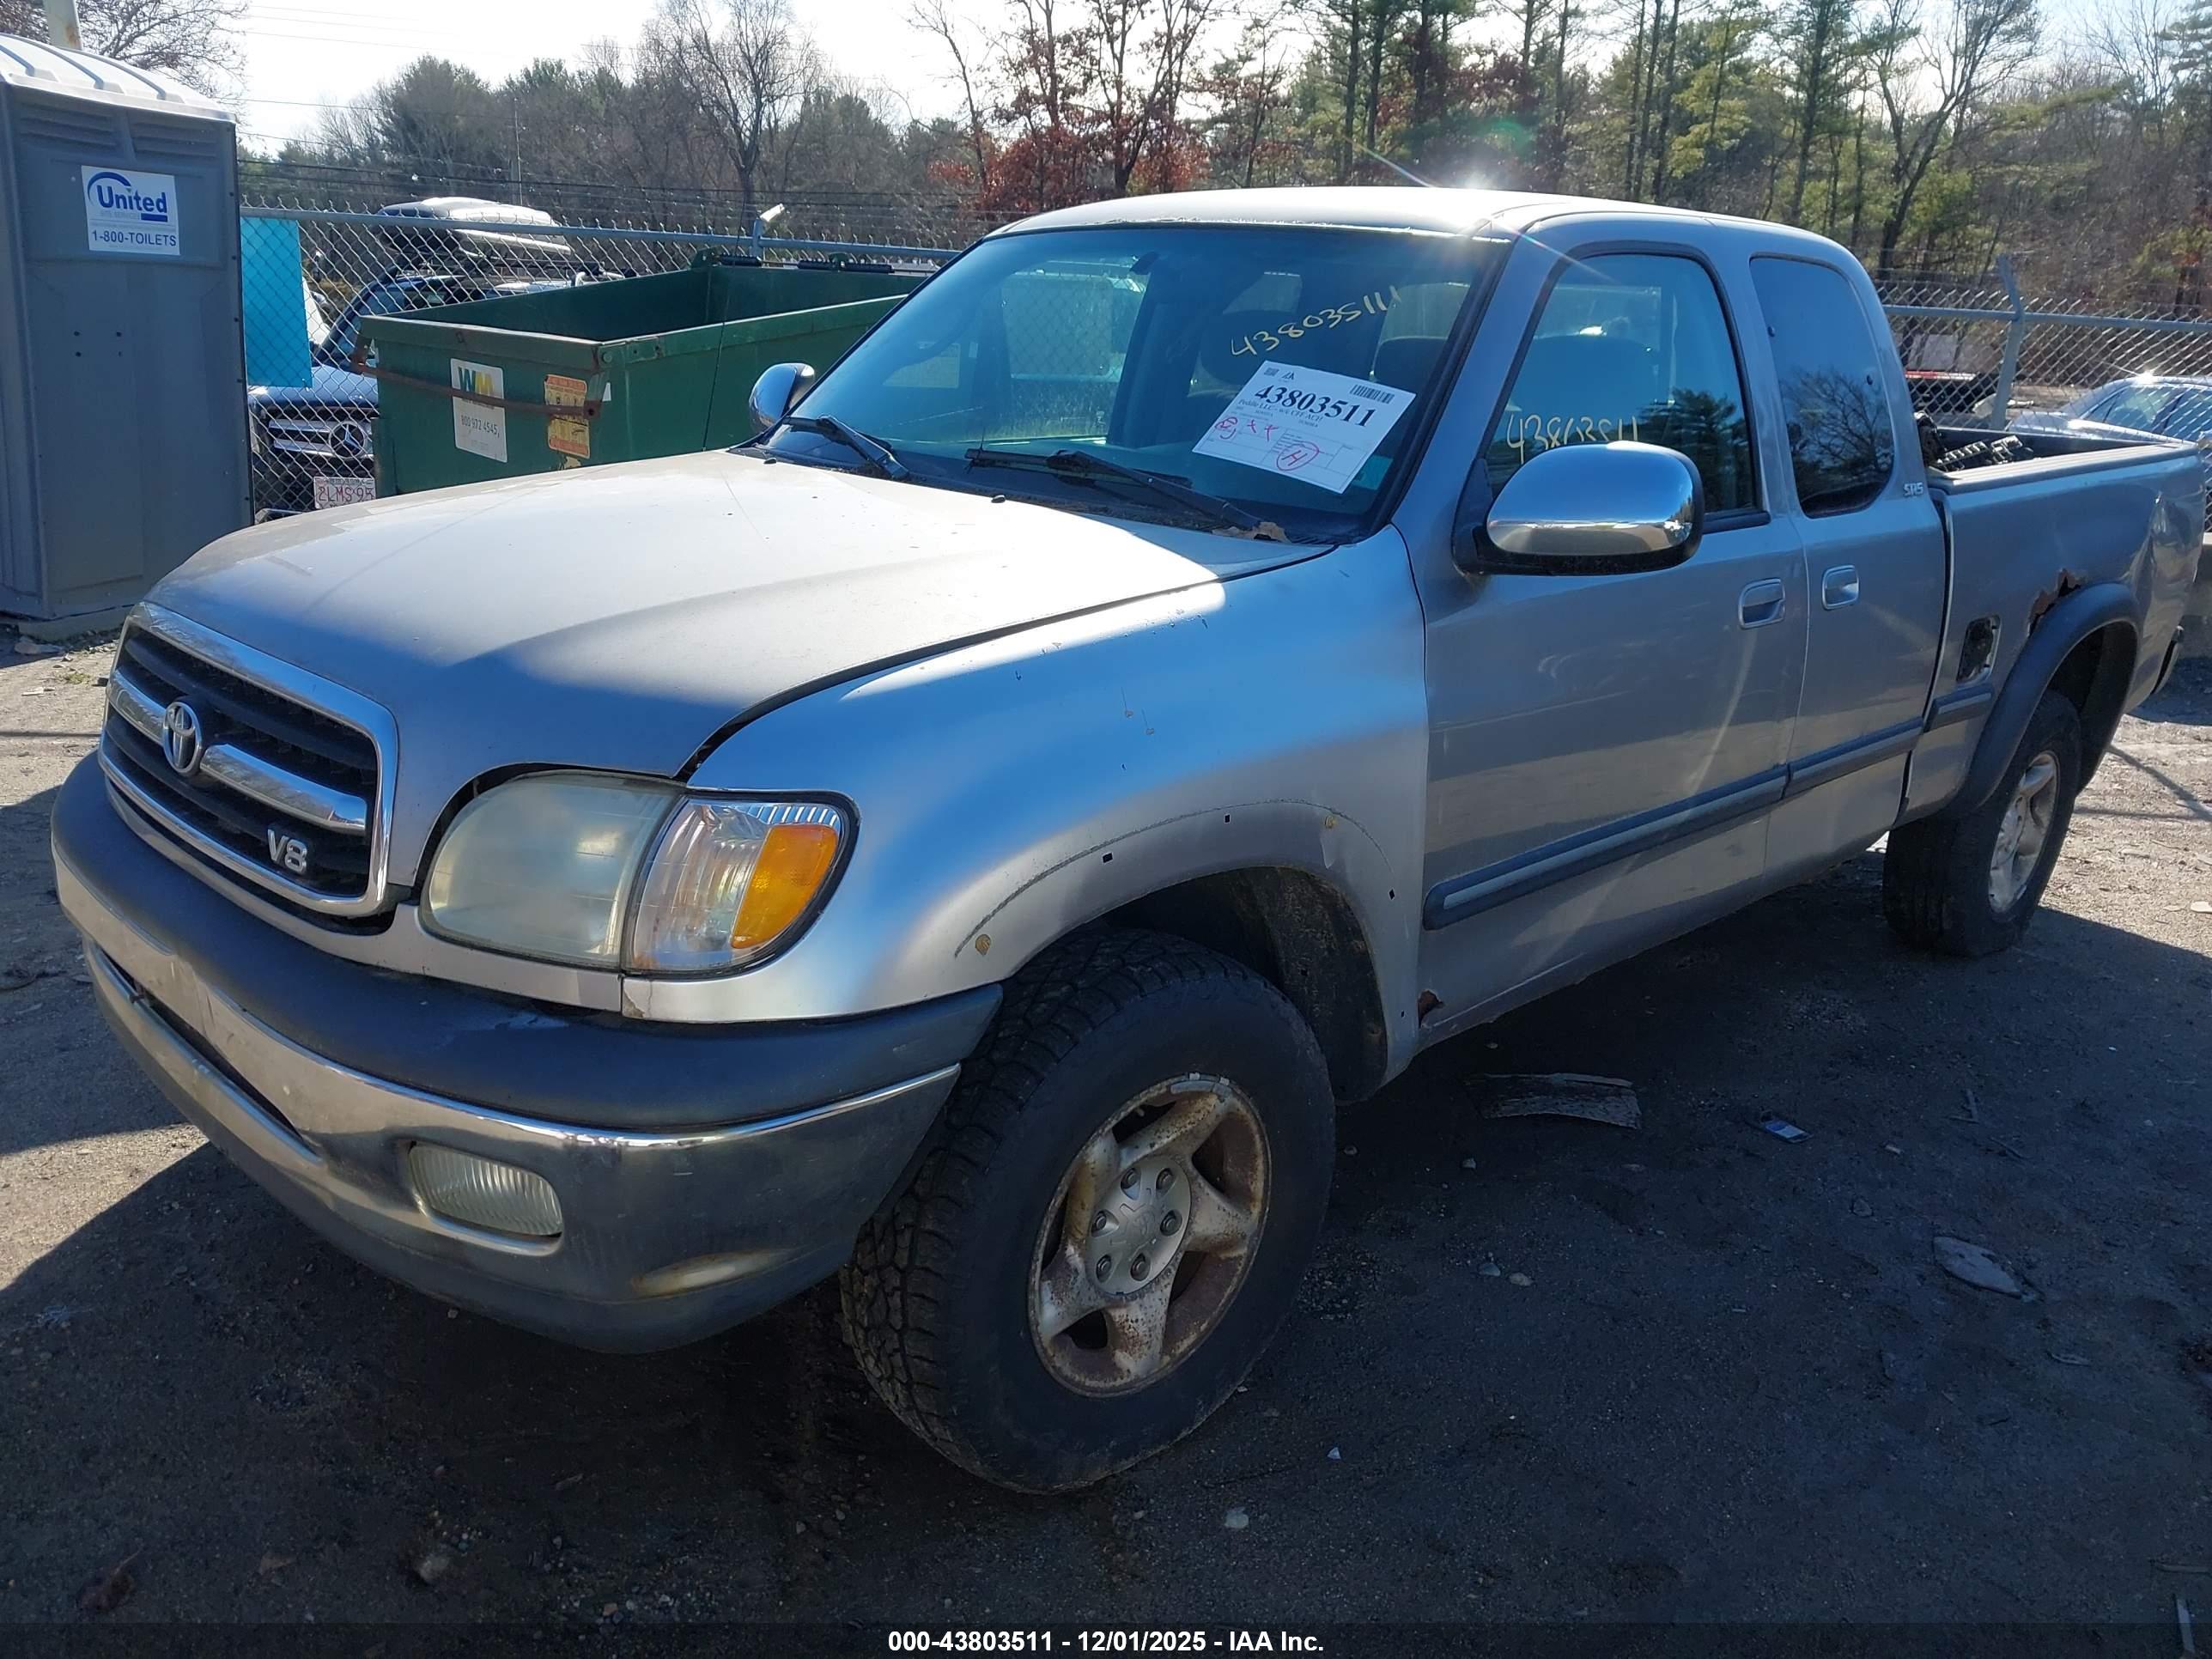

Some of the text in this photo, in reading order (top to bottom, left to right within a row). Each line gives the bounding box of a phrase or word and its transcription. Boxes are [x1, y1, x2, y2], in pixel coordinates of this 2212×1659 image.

[96, 185, 167, 213] United
[92, 229, 177, 246] 1-800-TOILETS
[458, 367, 494, 395] WM
[1255, 385, 1376, 427] 43803511
[267, 829, 307, 872] V8
